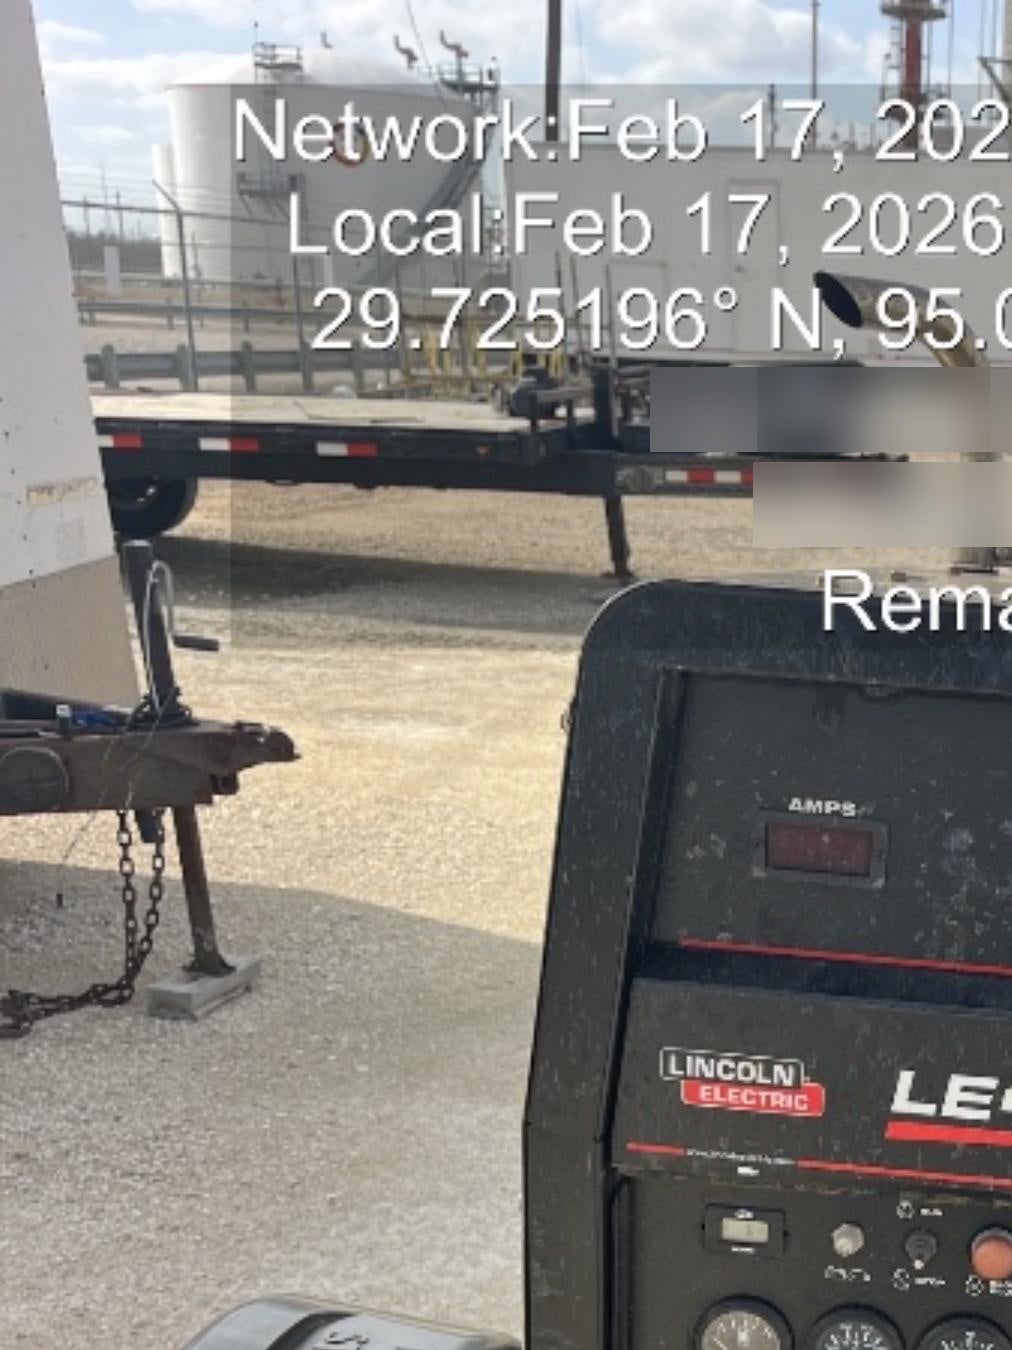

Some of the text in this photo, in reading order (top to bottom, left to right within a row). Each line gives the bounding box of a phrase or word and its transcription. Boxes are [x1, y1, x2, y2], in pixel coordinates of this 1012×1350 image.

[788, 797, 857, 818] AMPS
[667, 1052, 797, 1087] LINCOLN
[699, 1084, 809, 1112] ELECTRIC
